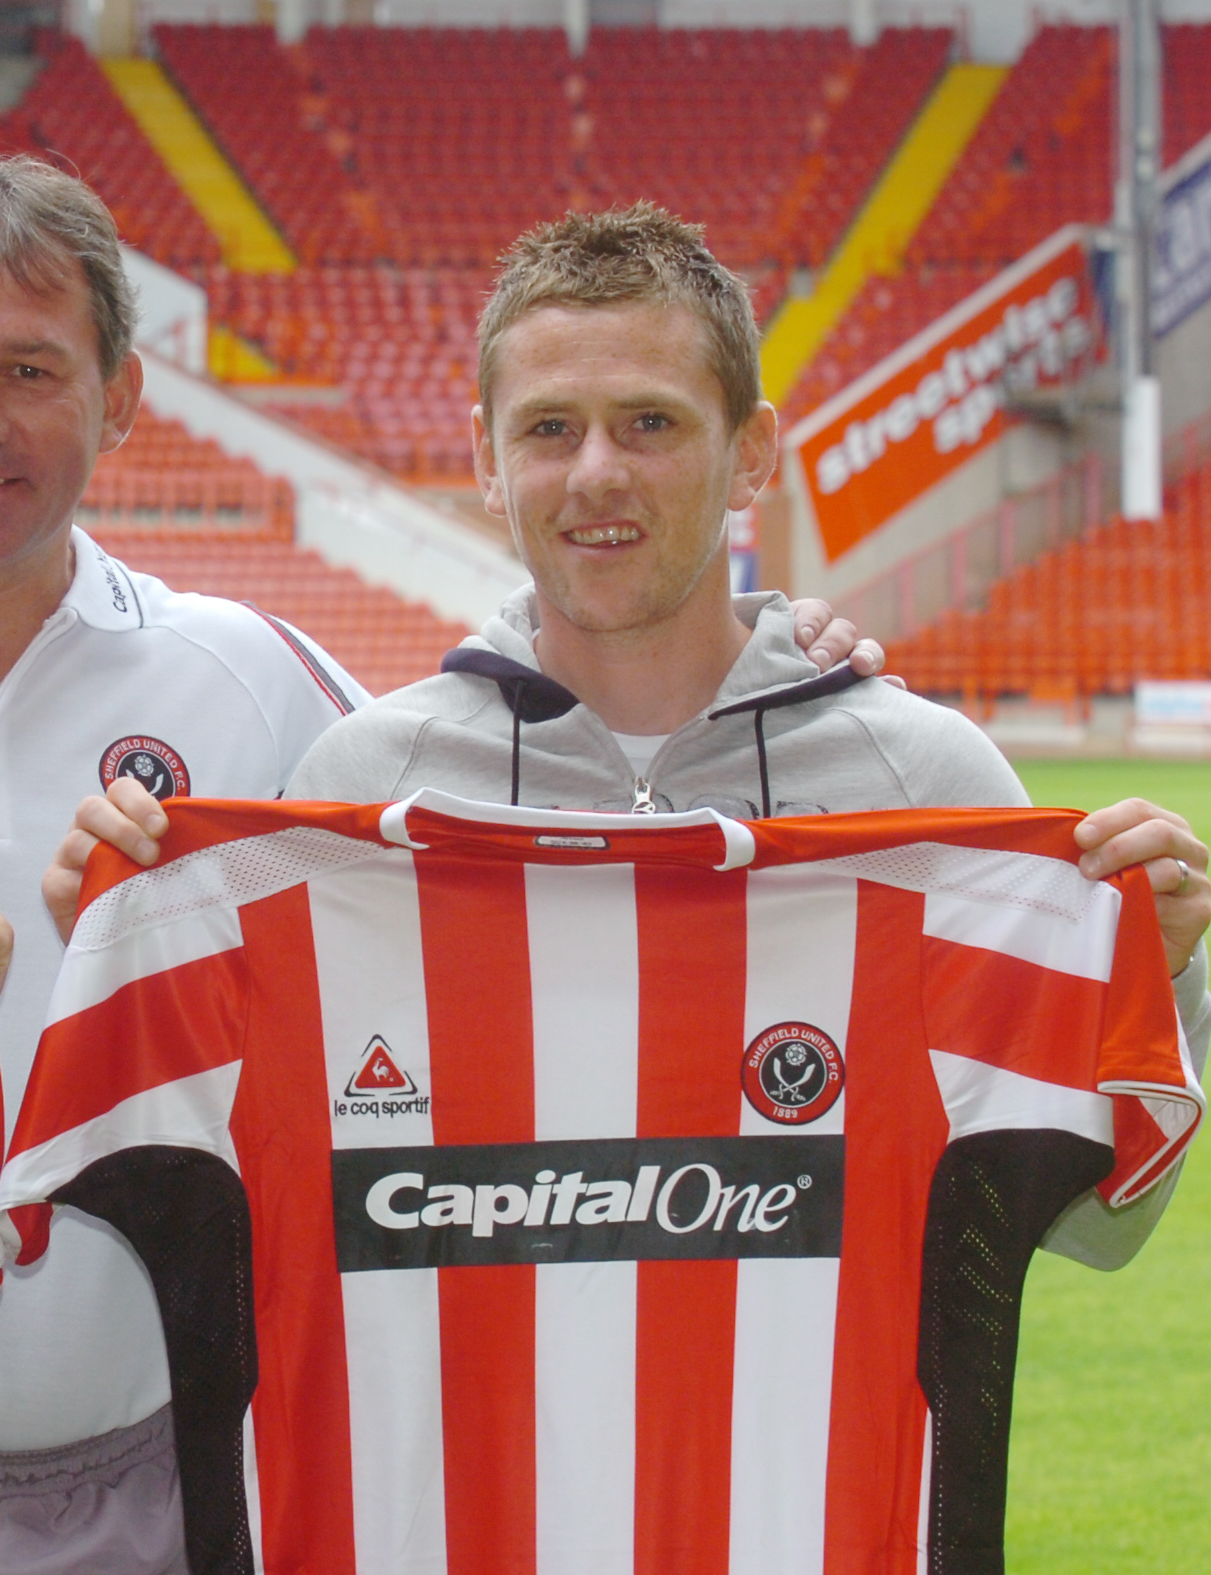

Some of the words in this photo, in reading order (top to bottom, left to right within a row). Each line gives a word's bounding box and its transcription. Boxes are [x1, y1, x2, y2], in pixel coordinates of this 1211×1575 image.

[933, 315, 1090, 455] sprts
[104, 738, 141, 780] SHEFFIELD
[142, 740, 178, 769] UNITED
[748, 1027, 799, 1069] SHEFFIELD
[800, 1029, 835, 1060] UNITED
[334, 1099, 348, 1117] le
[350, 1101, 380, 1119] coq
[381, 1096, 430, 1119] sportif
[772, 1105, 799, 1119] 1889
